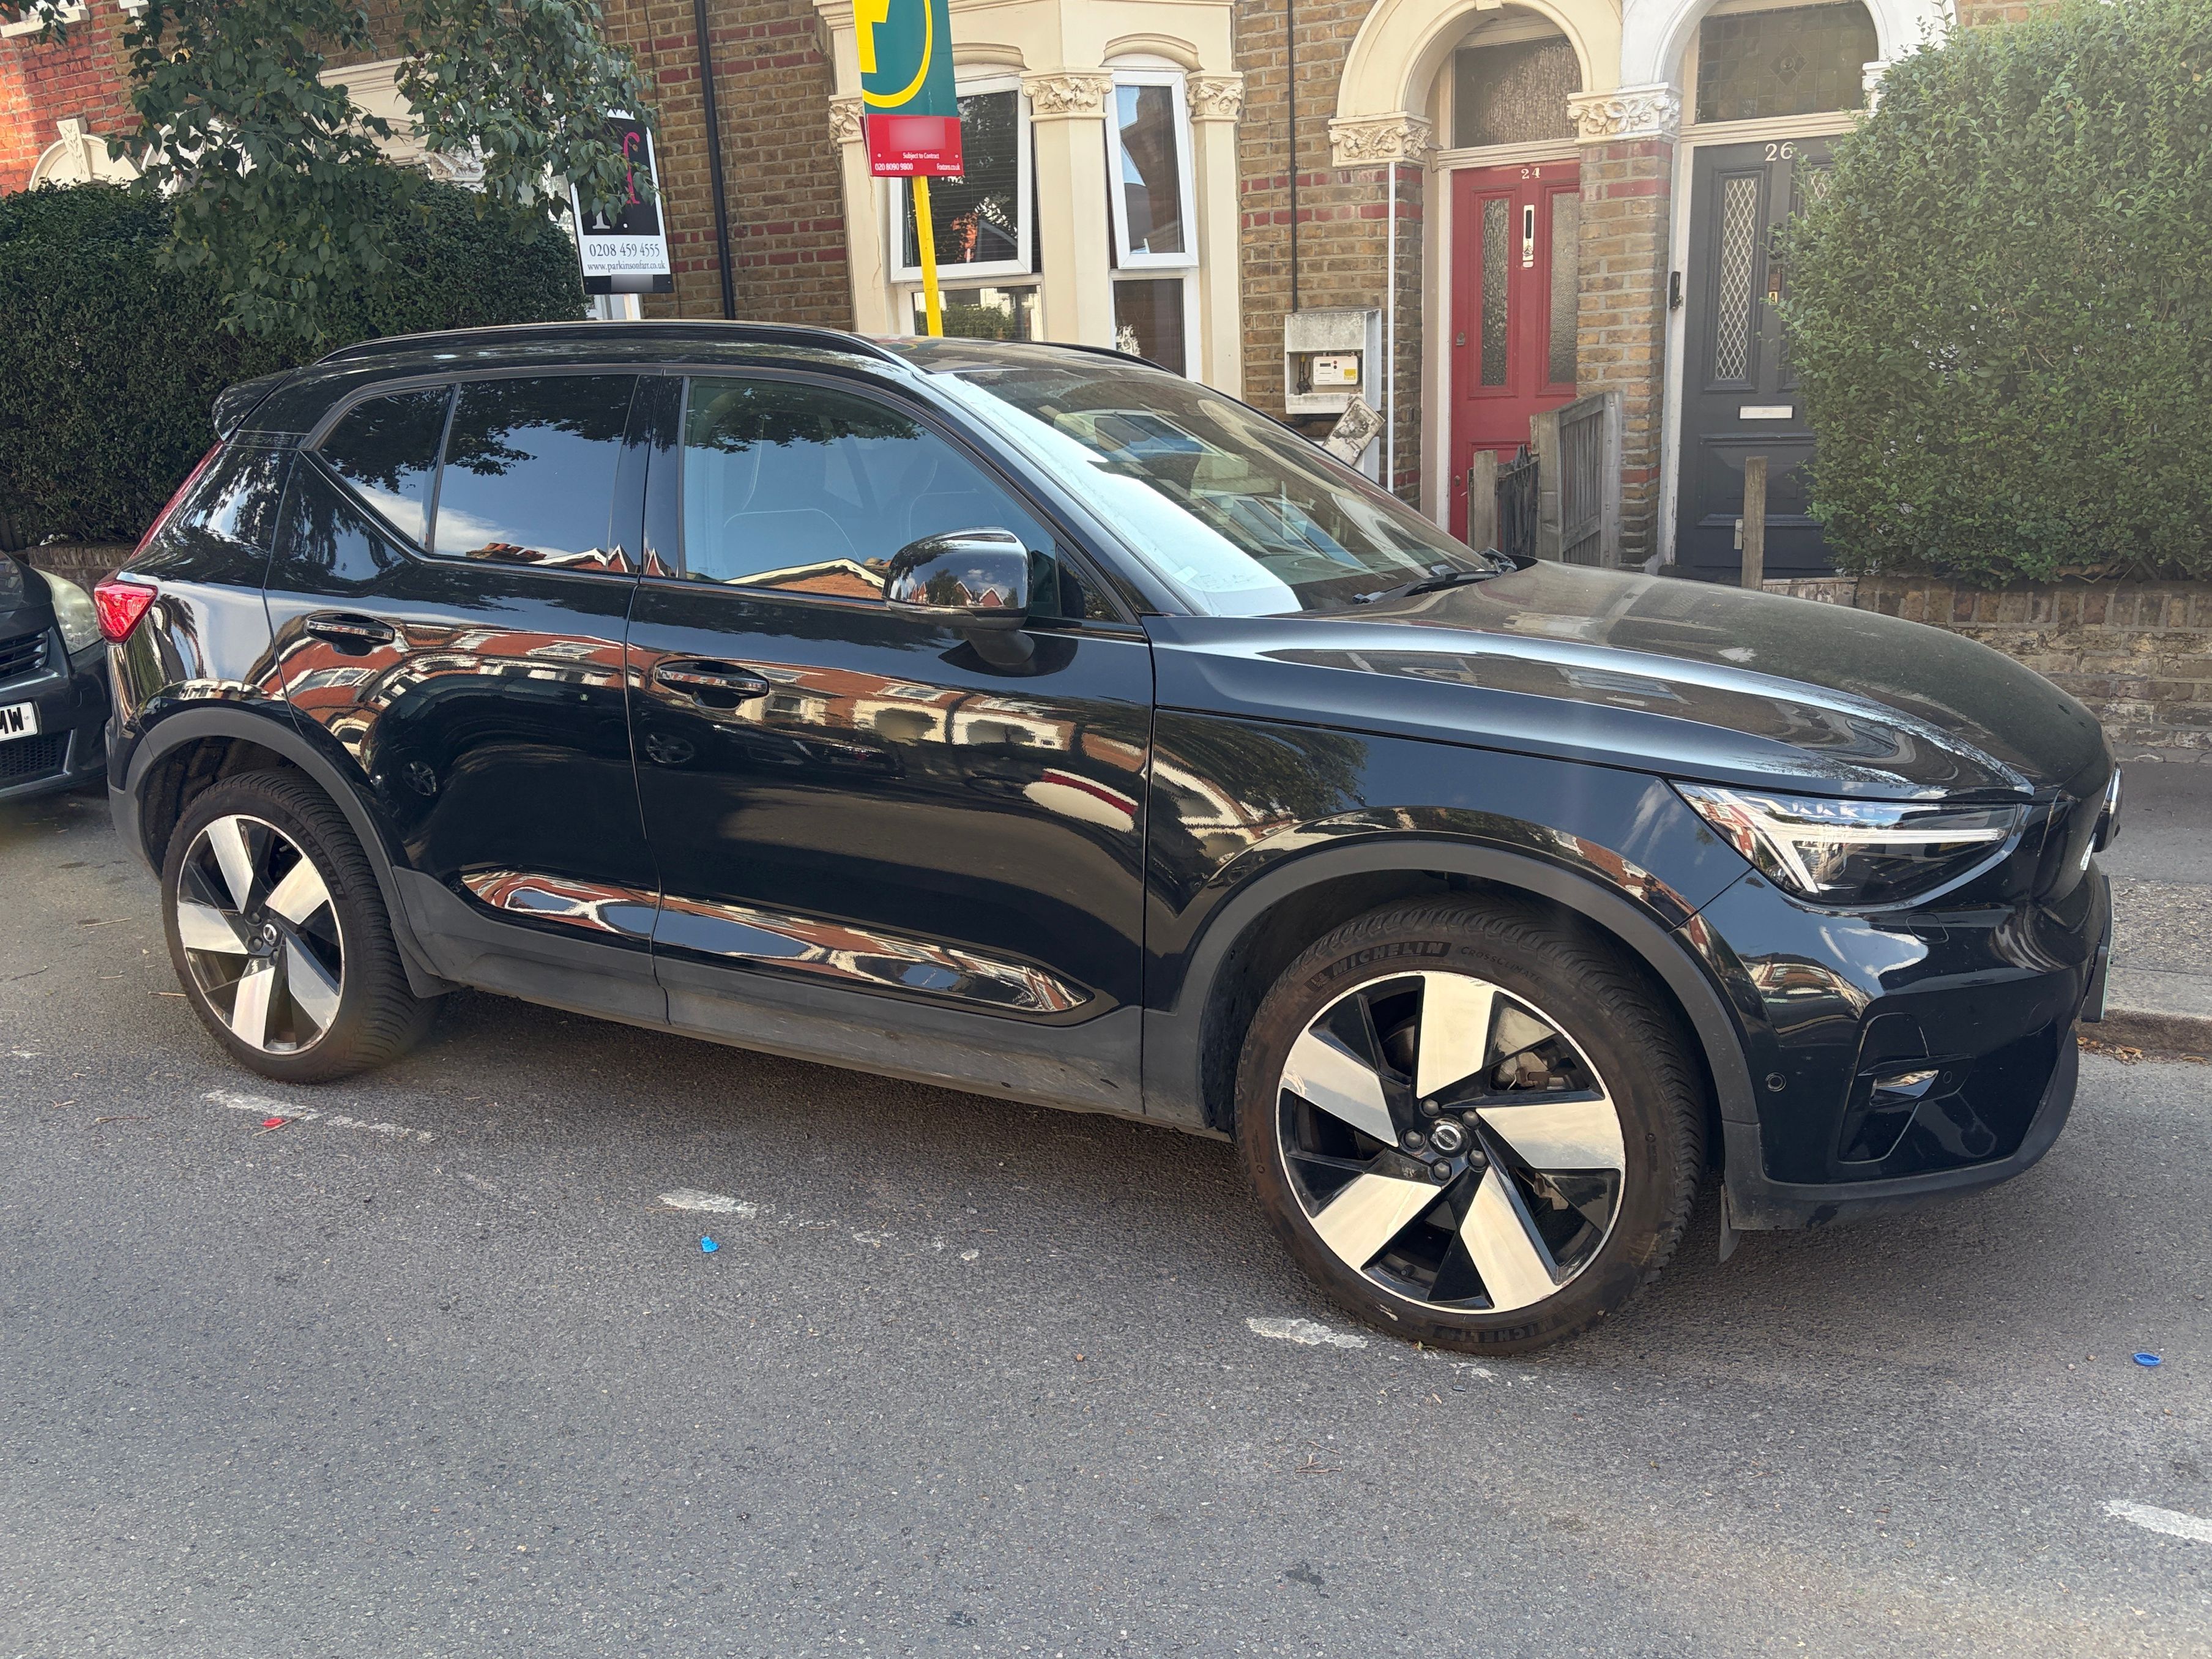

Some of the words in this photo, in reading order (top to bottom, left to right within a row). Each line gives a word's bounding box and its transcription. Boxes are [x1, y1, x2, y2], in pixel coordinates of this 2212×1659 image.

[1765, 141, 1794, 161] 26
[1521, 167, 1541, 179] 24
[589, 244, 617, 256] 0208
[620, 242, 637, 257] 459
[640, 242, 660, 257] 4555
[587, 259, 666, 272] www.parkinsonfarr.co.uk
[288, 819, 344, 894] MICHELIN
[1332, 942, 1444, 976] MICHELIN
